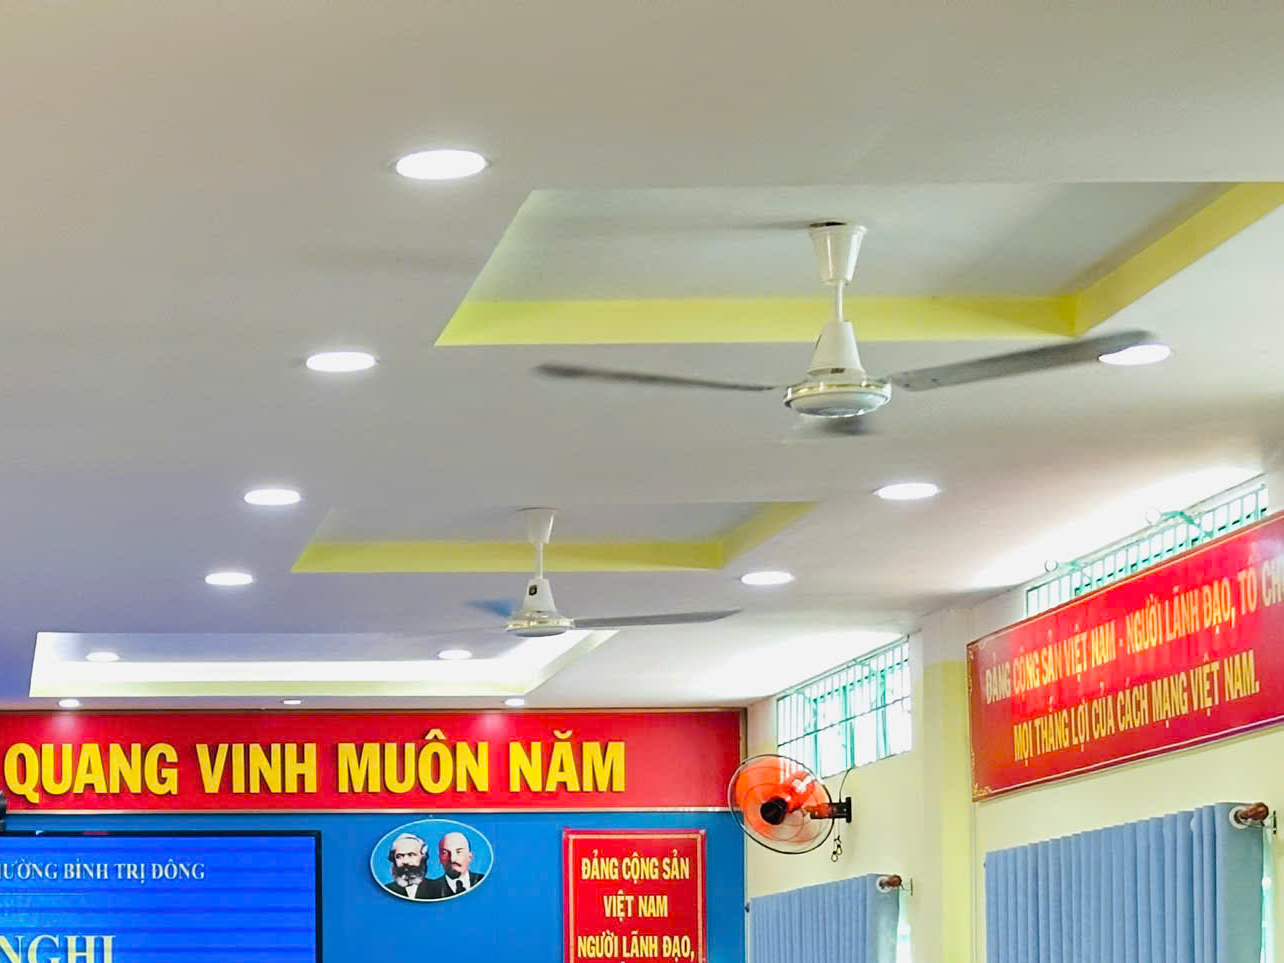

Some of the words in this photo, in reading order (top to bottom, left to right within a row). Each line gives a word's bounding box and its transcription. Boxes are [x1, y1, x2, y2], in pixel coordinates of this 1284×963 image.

[1013, 719, 1033, 767] MỌI
[1035, 696, 1069, 755] THẮNG
[1071, 698, 1090, 752] LỢI
[1092, 681, 1116, 740] CỦA
[1117, 677, 1148, 732] CÁCH
[1151, 672, 1188, 728] MẠNG
[1190, 652, 1220, 717] VIỆT
[4, 743, 178, 803] QUANG
[197, 743, 317, 794] VINH
[338, 728, 488, 794] MUÔN
[509, 729, 625, 793] NĂM
[114, 863, 145, 884] TRỊ
[151, 858, 205, 880] ĐÔNG
[581, 849, 619, 880] ĐẢNG
[622, 852, 659, 884] CỘNG
[662, 849, 689, 880] SẢN
[603, 889, 634, 922] VIỆT
[638, 895, 668, 918] NAM
[578, 929, 618, 958] NGƯỜI
[622, 931, 658, 958] LÃNH
[662, 936, 695, 962] ĐẠO,
